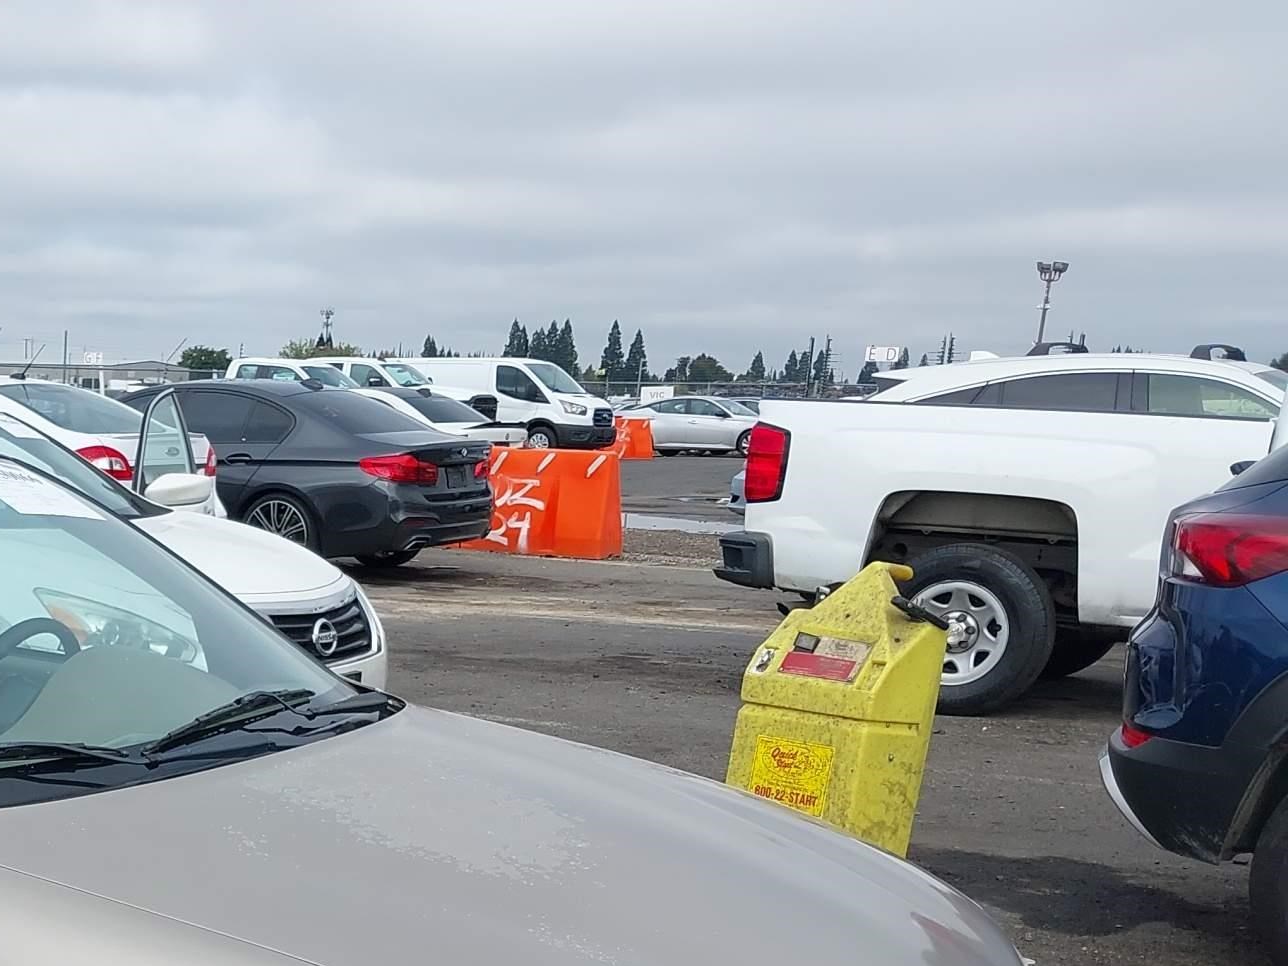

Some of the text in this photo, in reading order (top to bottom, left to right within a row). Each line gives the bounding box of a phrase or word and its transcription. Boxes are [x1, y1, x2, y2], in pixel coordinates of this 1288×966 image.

[887, 347, 897, 361] D
[486, 511, 531, 553] 24
[771, 747, 798, 761] Quick
